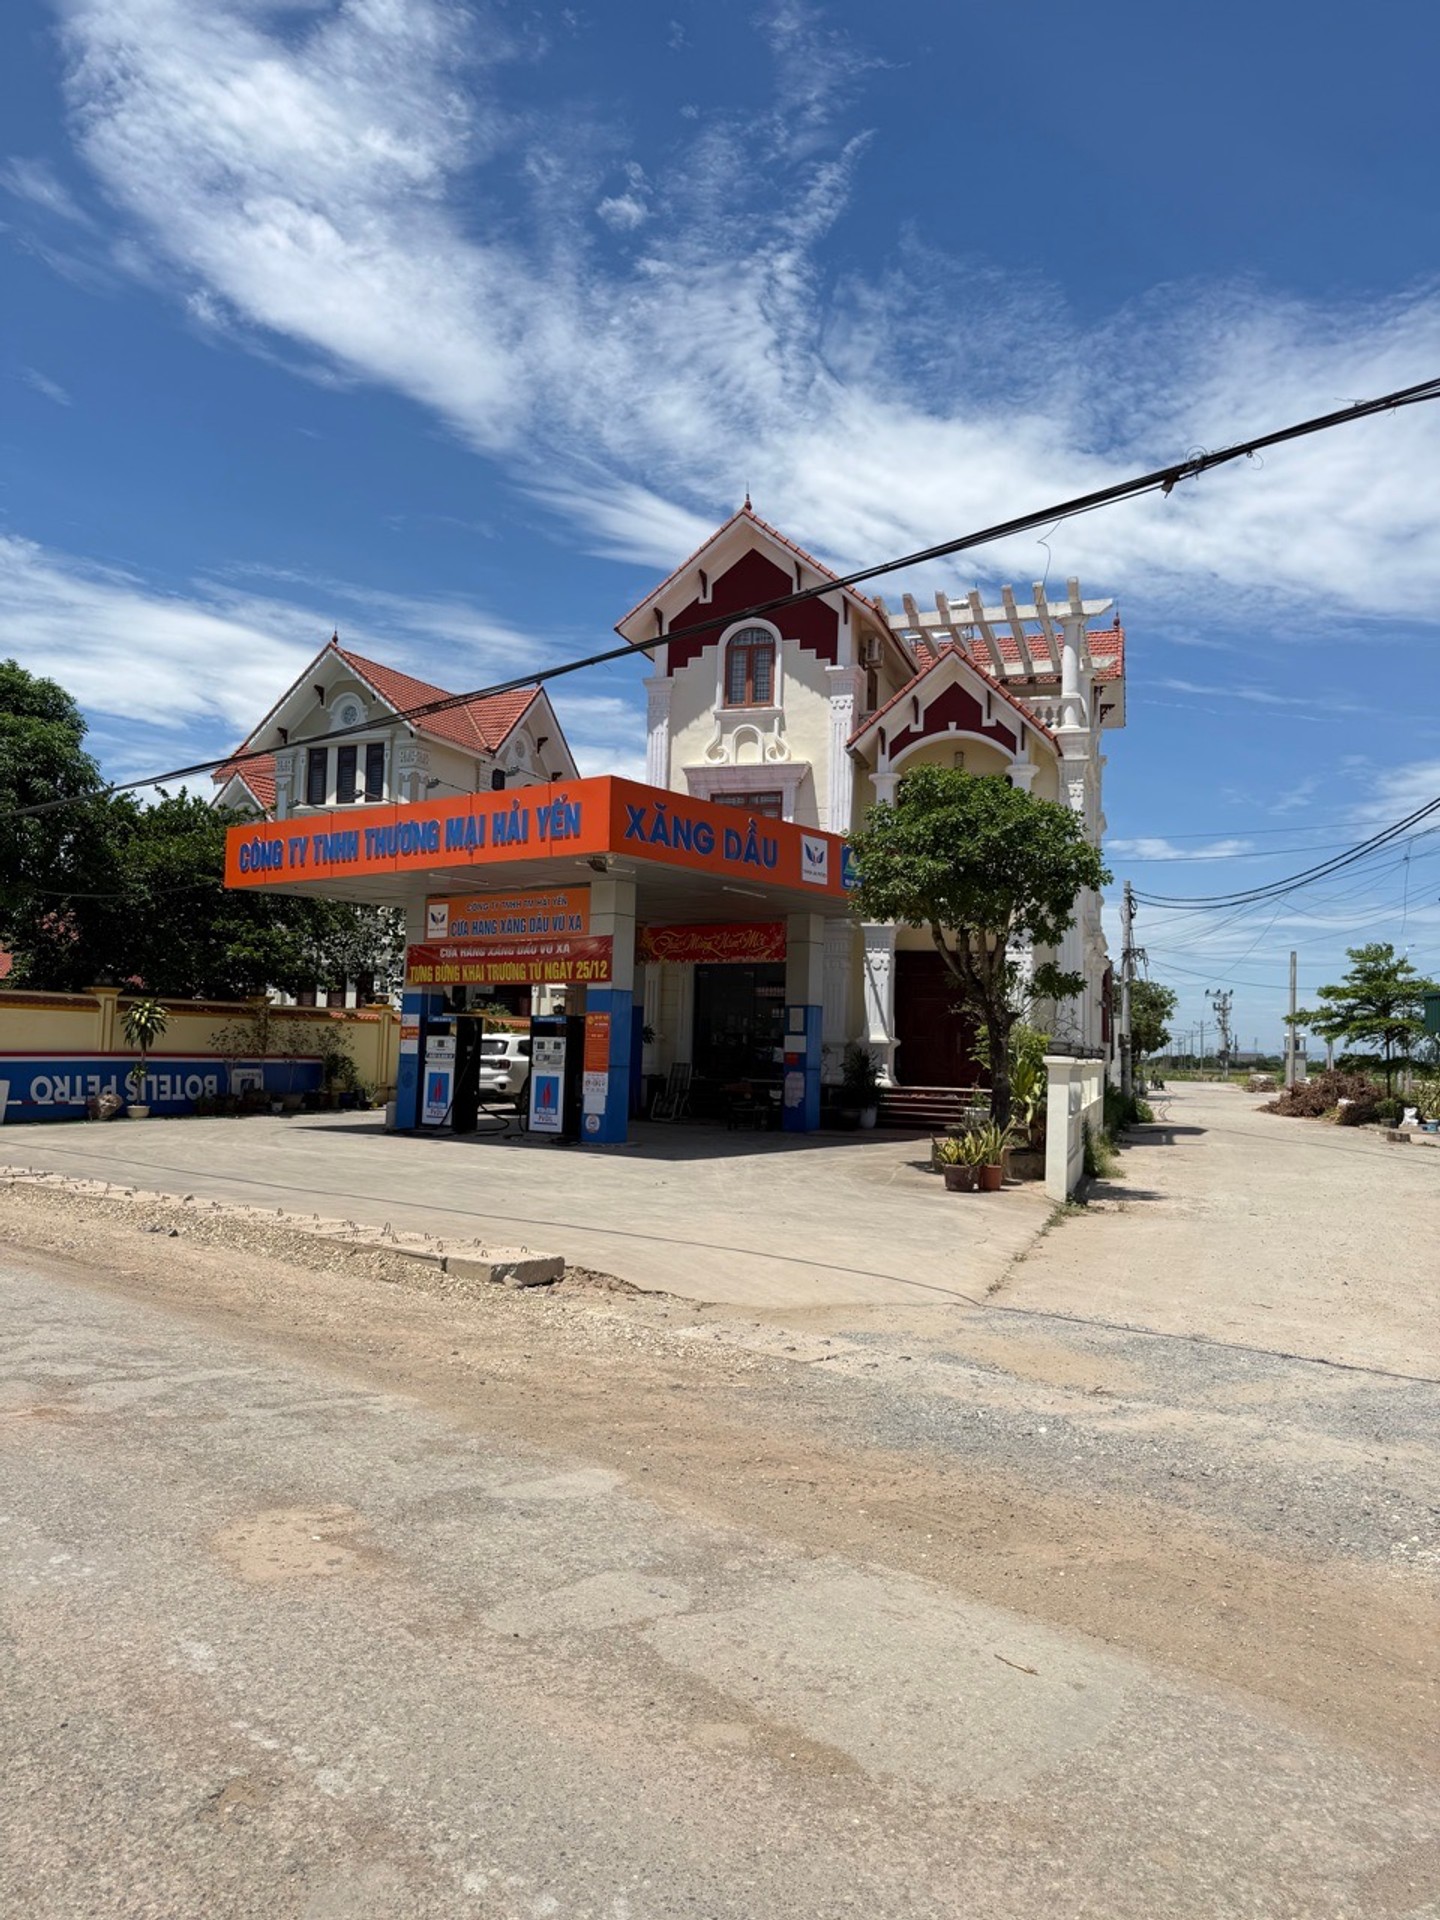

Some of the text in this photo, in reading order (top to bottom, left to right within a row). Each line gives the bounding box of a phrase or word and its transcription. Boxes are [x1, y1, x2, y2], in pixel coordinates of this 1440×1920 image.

[239, 835, 284, 874] CÔNG
[288, 836, 309, 869] TY
[312, 830, 359, 867] TNHH
[364, 820, 440, 861] THƯƠNG
[445, 814, 486, 856] MẠI
[491, 798, 529, 848] HẢI
[624, 801, 779, 870] XĂNG DẦU
[462, 963, 485, 982] KHAI
[544, 957, 573, 980] NGÀY
[576, 959, 608, 980] 25/12
[30, 1075, 117, 1101] PETRO
